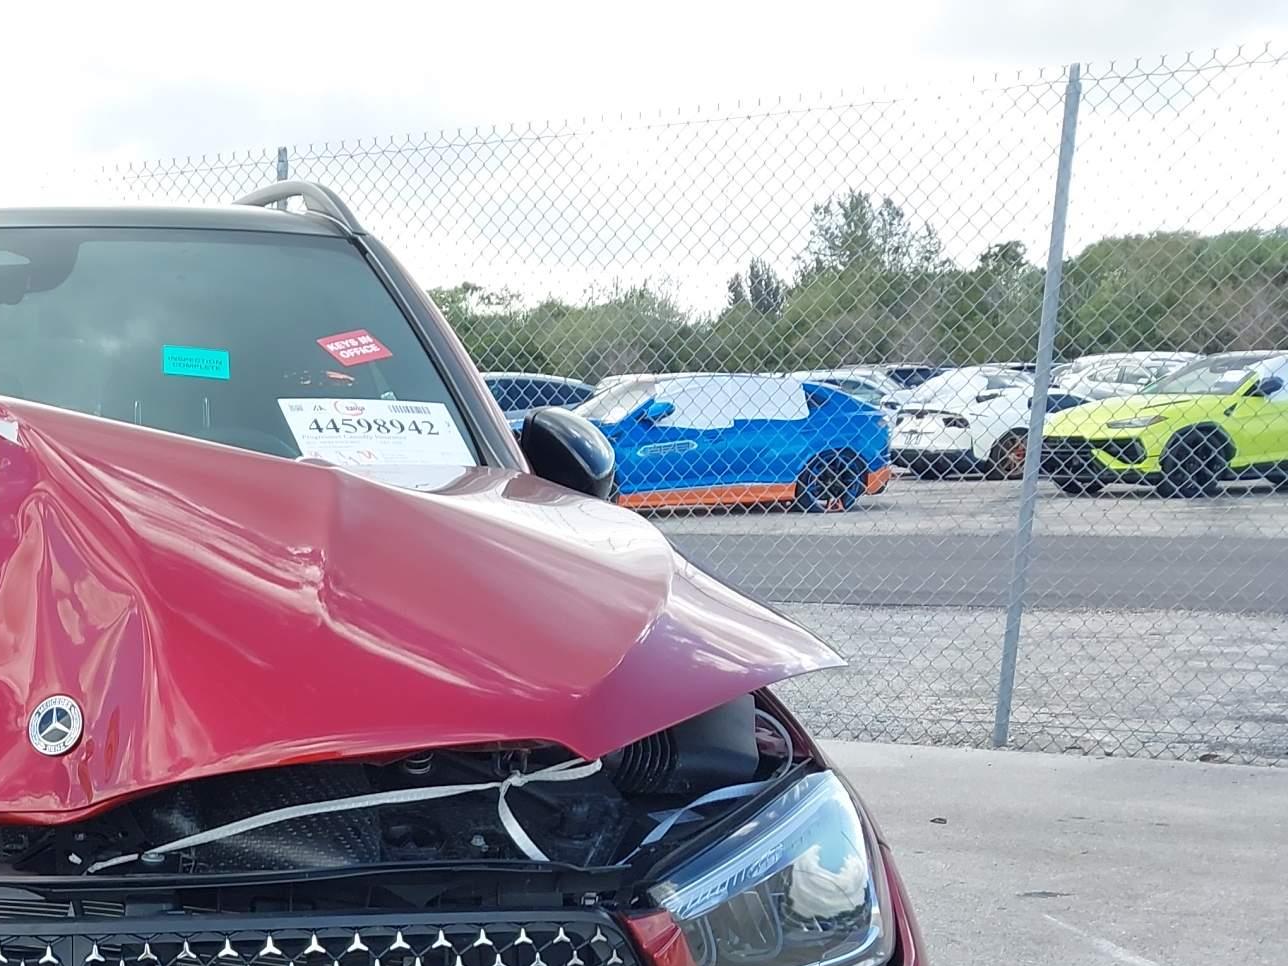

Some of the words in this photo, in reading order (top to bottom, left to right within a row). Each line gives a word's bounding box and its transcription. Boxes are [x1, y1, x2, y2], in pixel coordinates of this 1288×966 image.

[326, 338, 359, 352] KEYS
[357, 334, 374, 345] IN
[339, 344, 381, 359] OFFICE
[308, 418, 440, 436] 44598942
